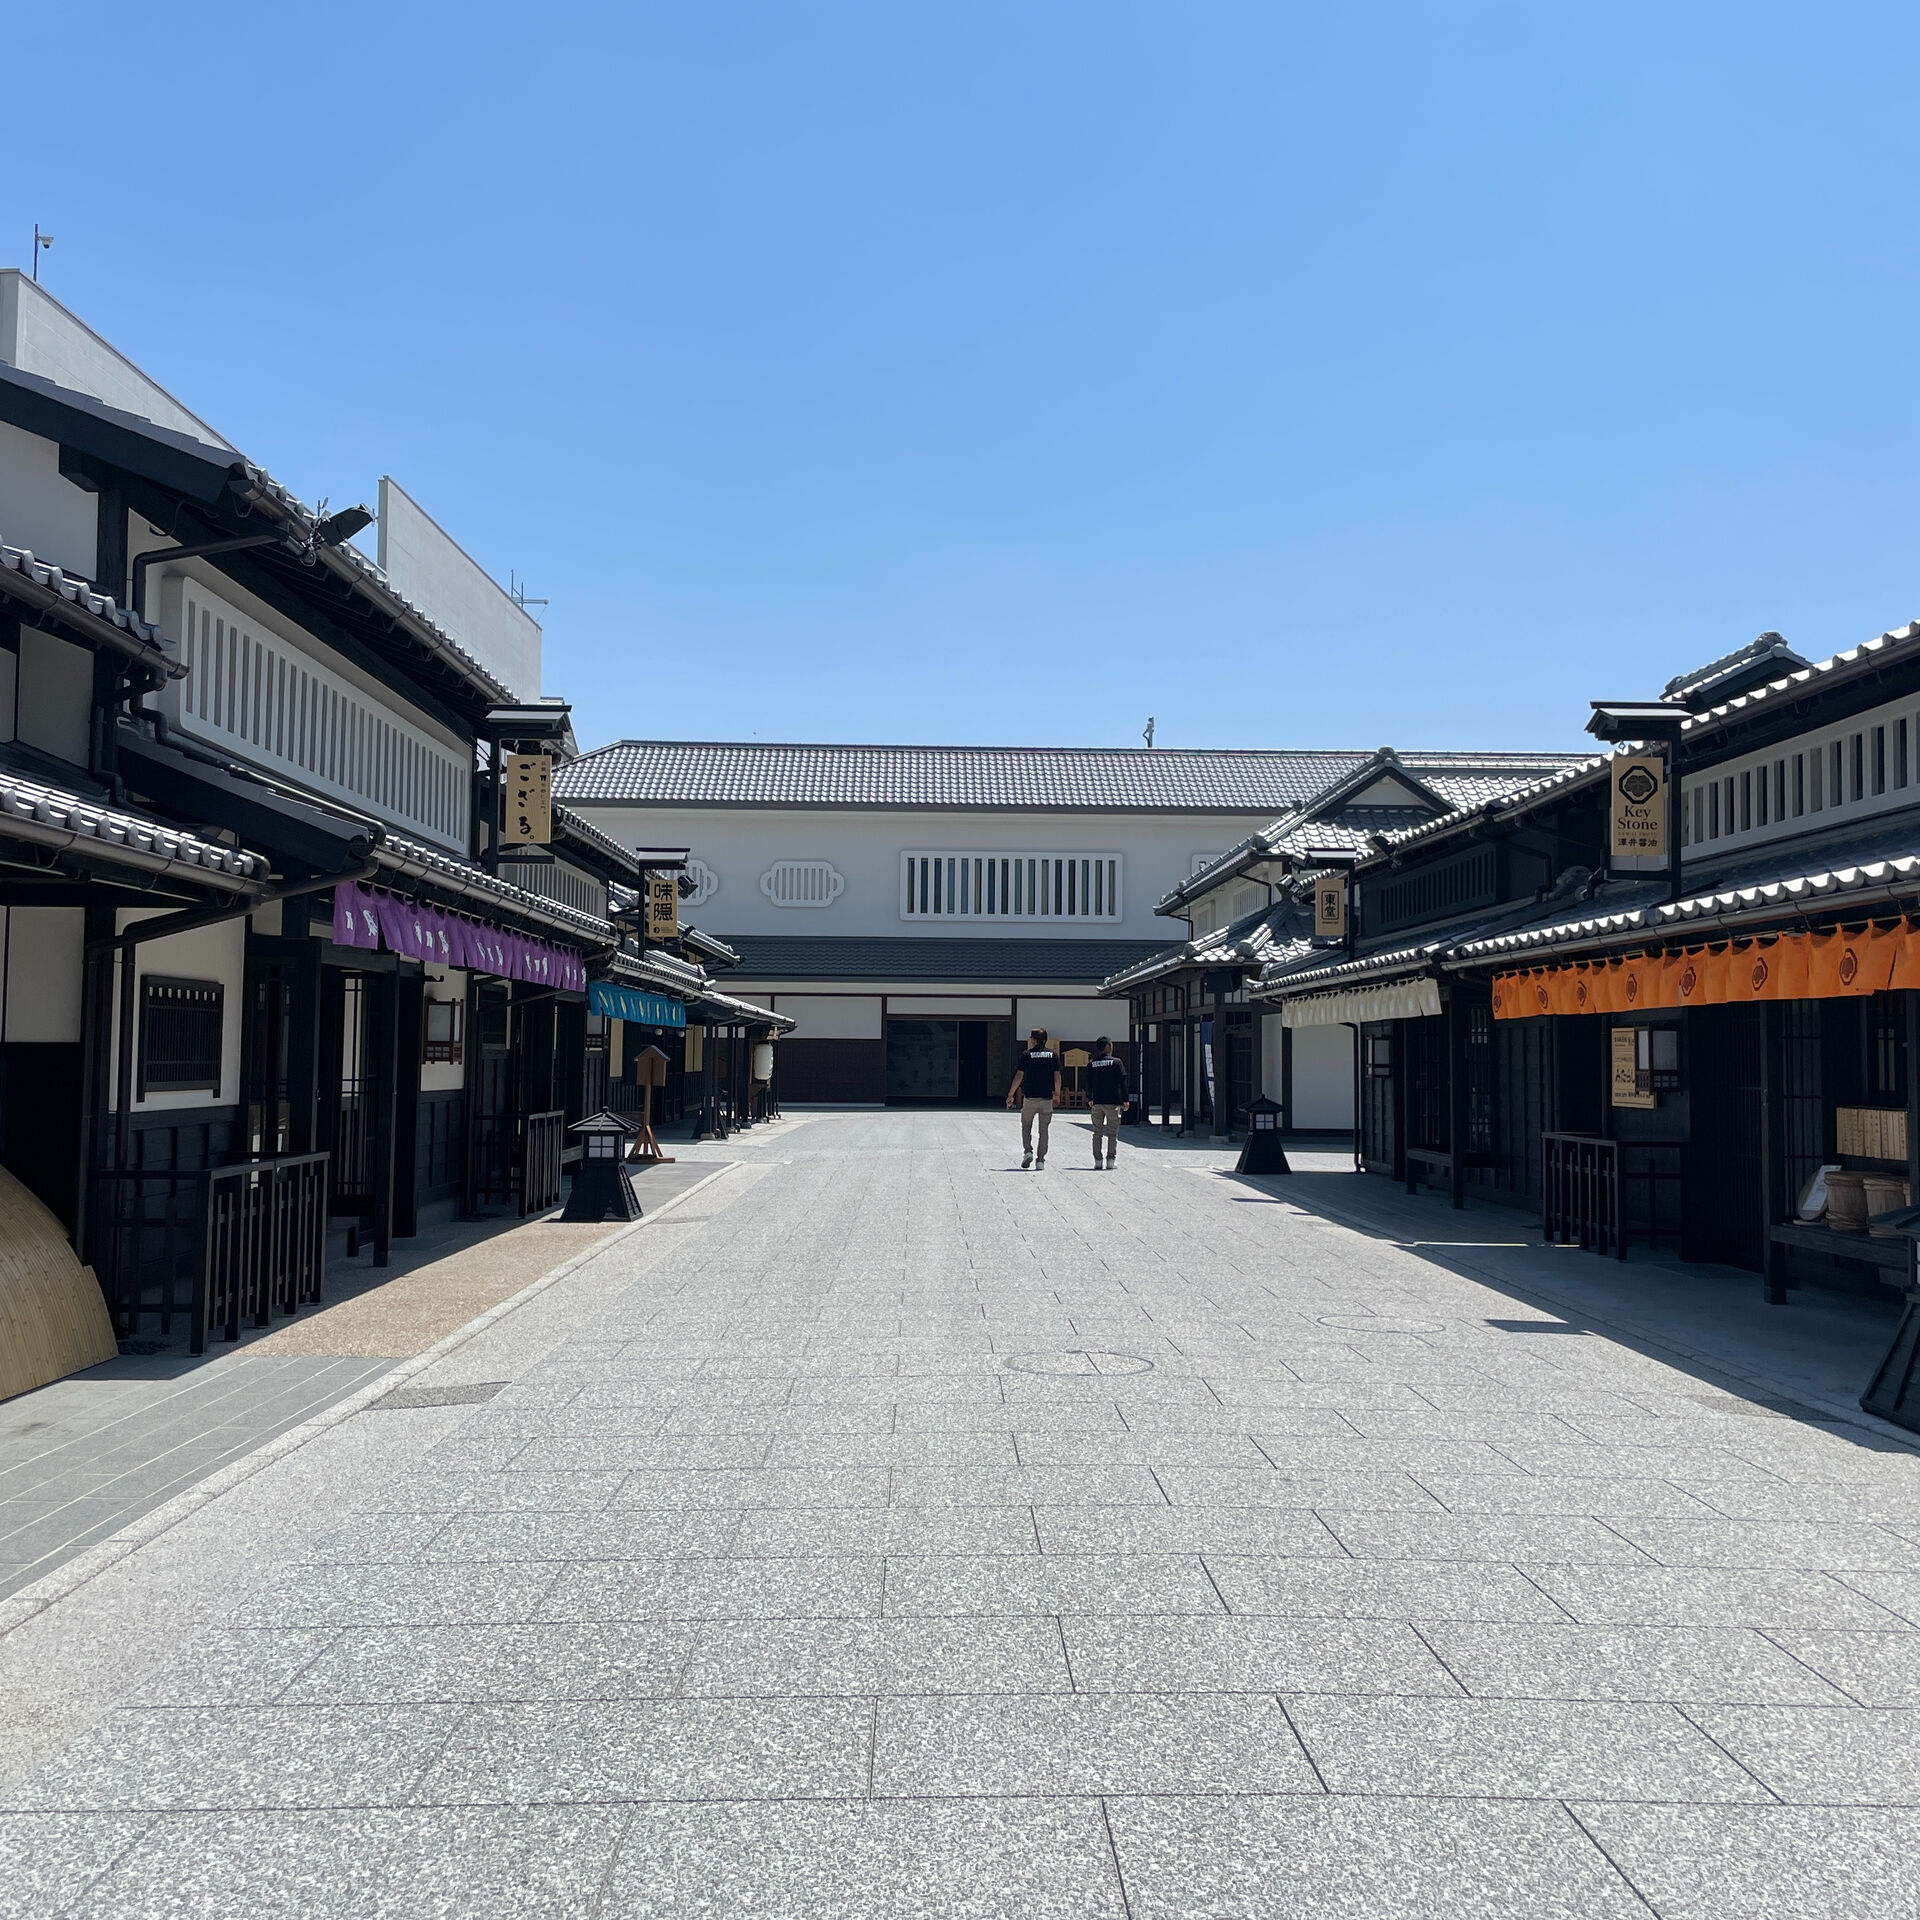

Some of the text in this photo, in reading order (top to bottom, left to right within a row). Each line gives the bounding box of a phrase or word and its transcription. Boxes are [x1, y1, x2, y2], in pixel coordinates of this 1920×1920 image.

[1624, 805, 1651, 820] Key
[1617, 817, 1658, 830] Stone
[653, 882, 674, 921] 味隠
[1030, 1051, 1053, 1059] SECURITY
[1091, 1060, 1114, 1068] SECURITY
